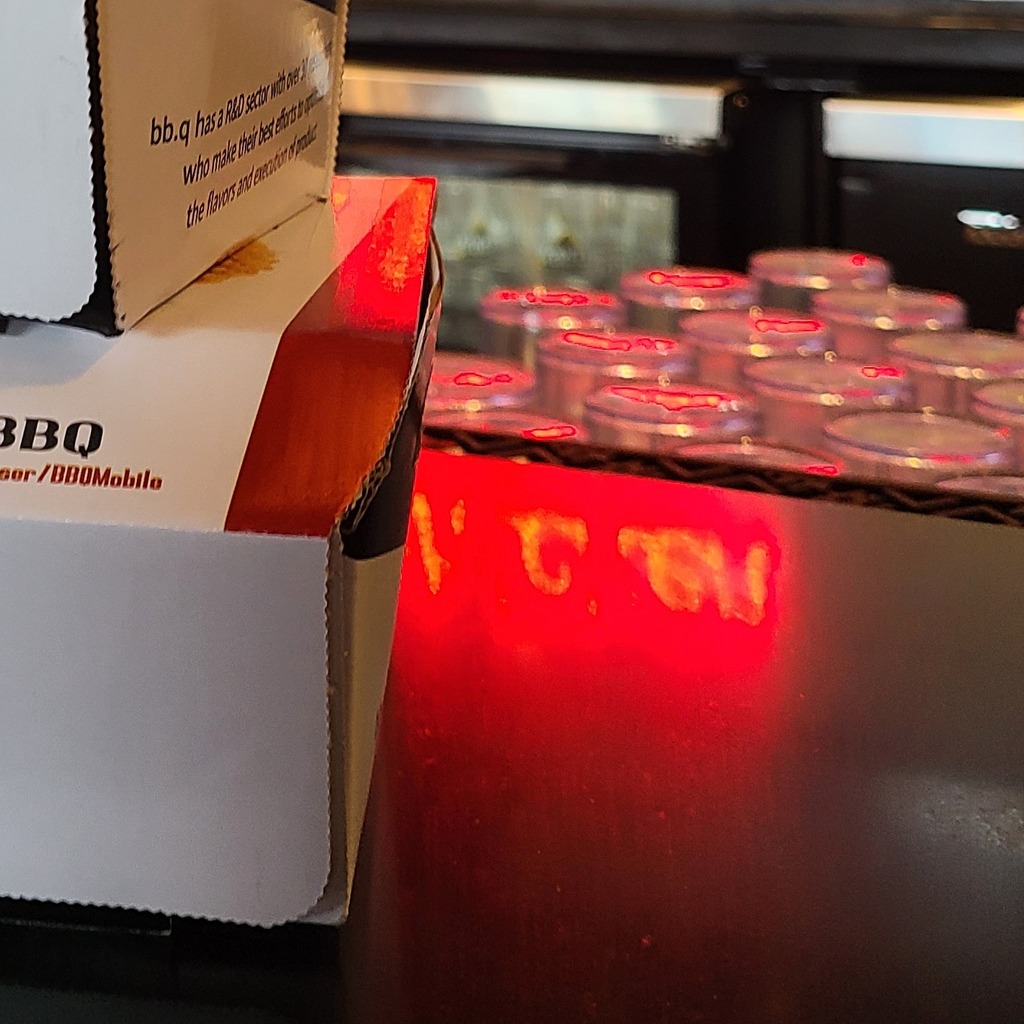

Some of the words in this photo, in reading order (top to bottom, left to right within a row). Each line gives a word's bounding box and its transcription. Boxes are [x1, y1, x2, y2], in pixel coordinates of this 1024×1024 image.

[150, 115, 190, 147] bb.q
[195, 109, 216, 138] has
[217, 107, 224, 129] a
[225, 93, 245, 125] R&D
[245, 84, 270, 115] sector
[270, 69, 285, 98] with
[183, 154, 210, 186] who
[211, 140, 237, 174] make
[238, 124, 258, 159] their
[258, 120, 275, 146] best
[186, 199, 205, 229] the
[206, 182, 236, 217] flavors
[236, 164, 255, 198] and
